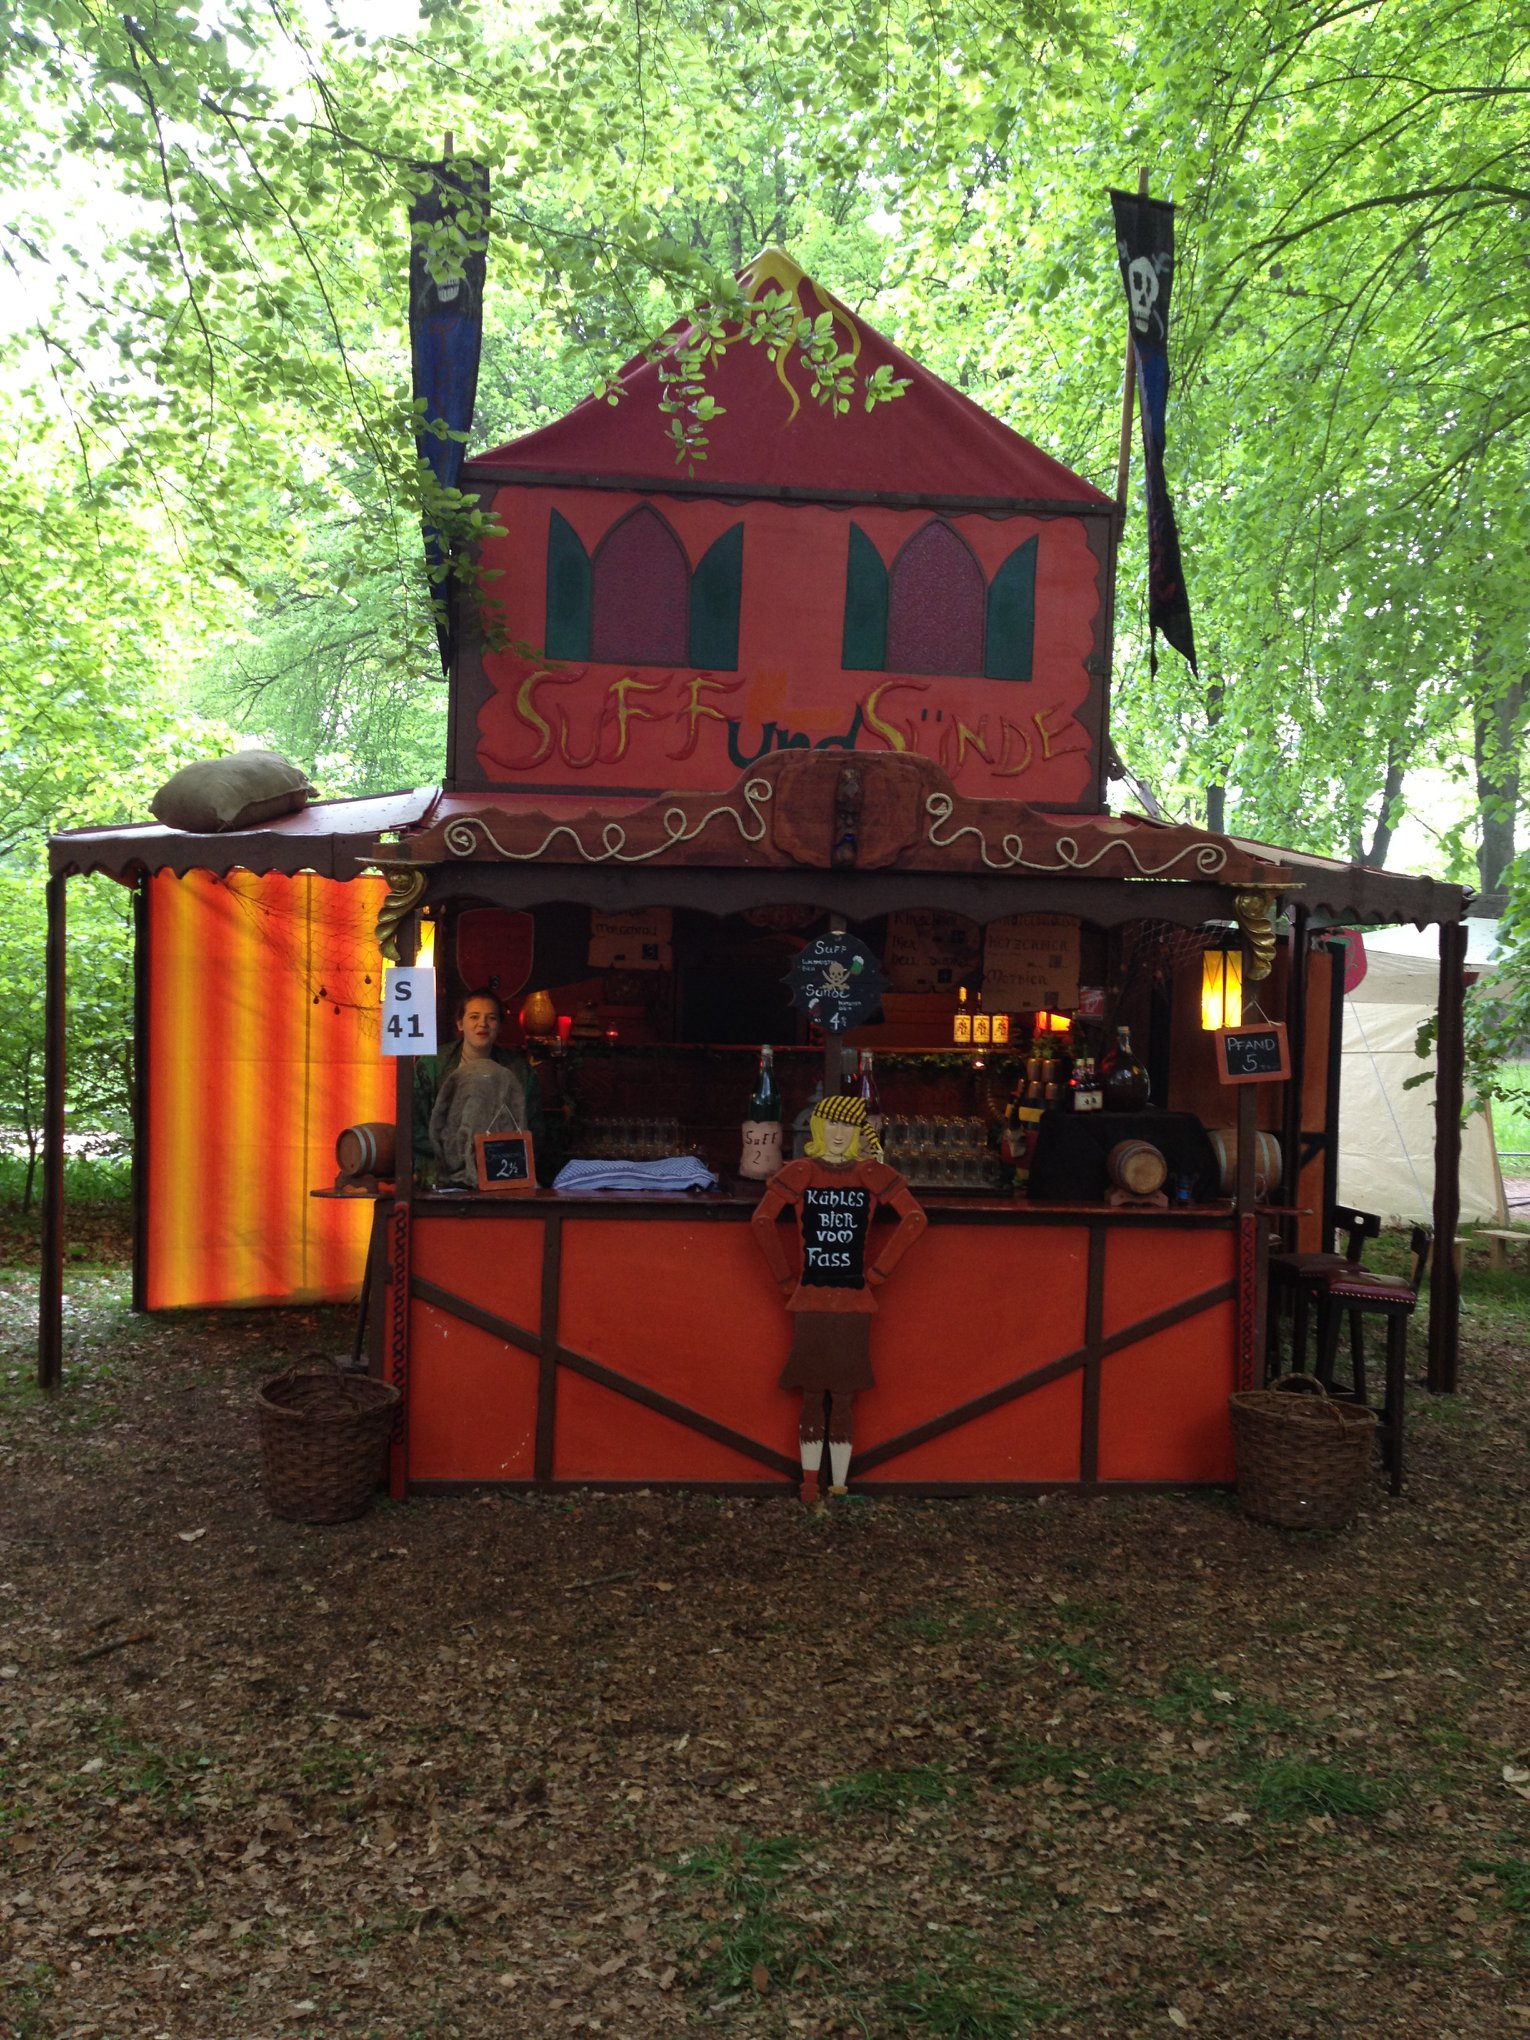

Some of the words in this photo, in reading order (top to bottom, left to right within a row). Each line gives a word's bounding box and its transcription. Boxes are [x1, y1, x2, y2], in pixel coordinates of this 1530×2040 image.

[478, 666, 745, 770] SUFF
[861, 677, 1087, 779] SÜNDE
[395, 981, 412, 1002] S
[387, 1014, 425, 1038] 41
[1227, 1036, 1276, 1051] PFAND
[1241, 1053, 1258, 1072] 5
[806, 1247, 851, 1267] Fass
